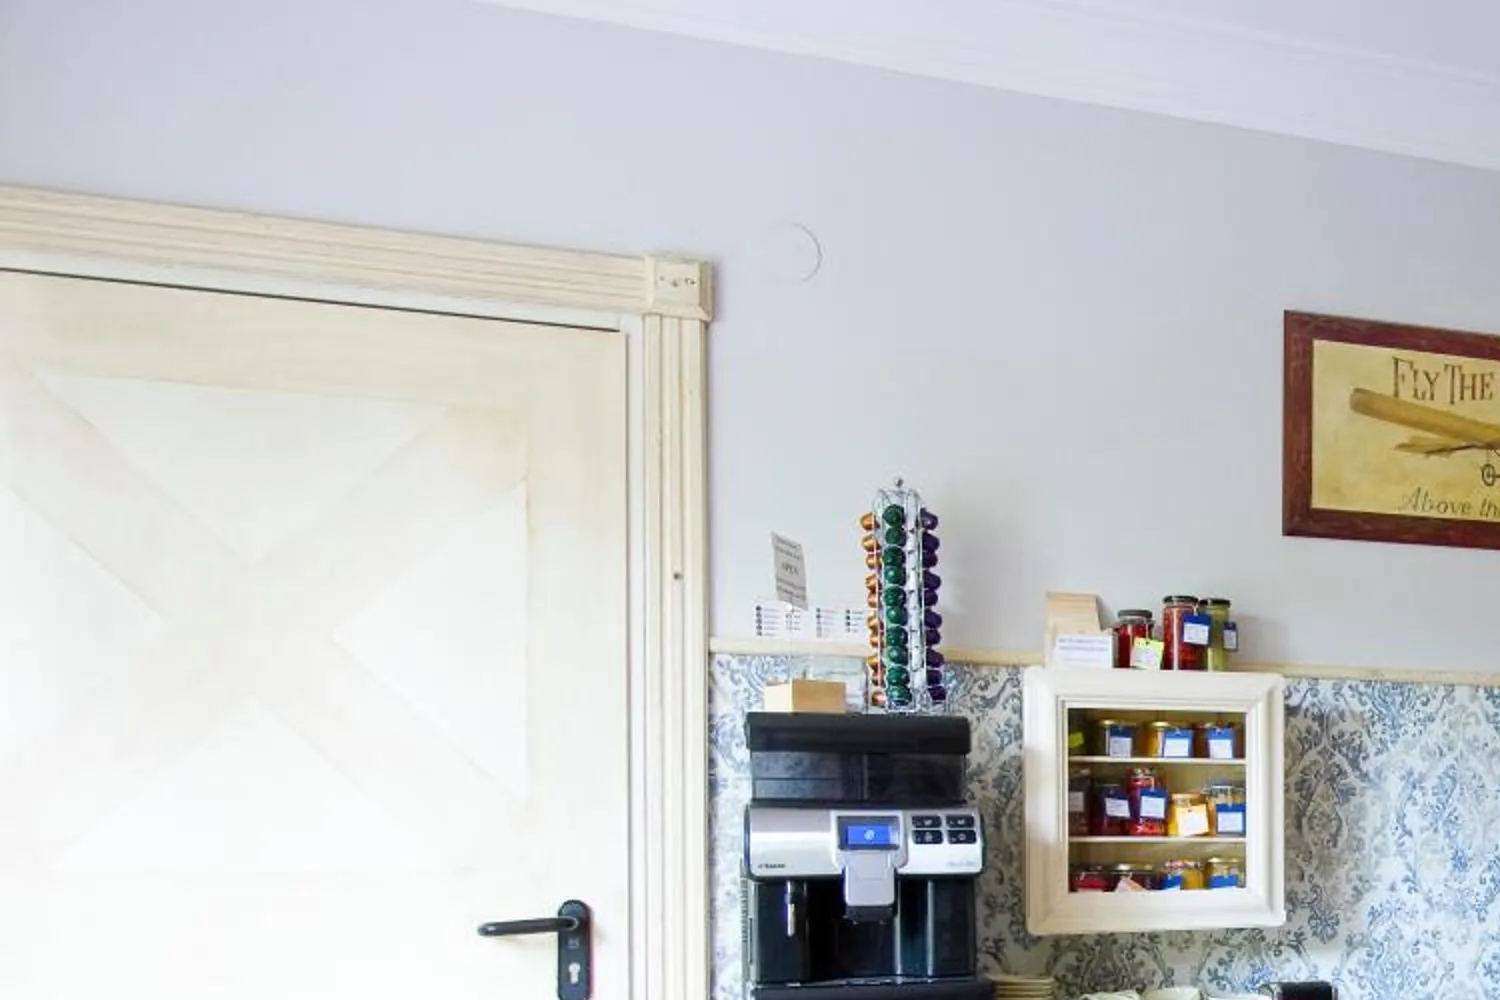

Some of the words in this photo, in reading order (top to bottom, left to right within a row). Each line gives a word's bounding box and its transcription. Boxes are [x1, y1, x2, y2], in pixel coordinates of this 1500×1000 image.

[1391, 356, 1440, 401] FLY
[1443, 364, 1494, 406] THE
[1405, 487, 1473, 515] Above
